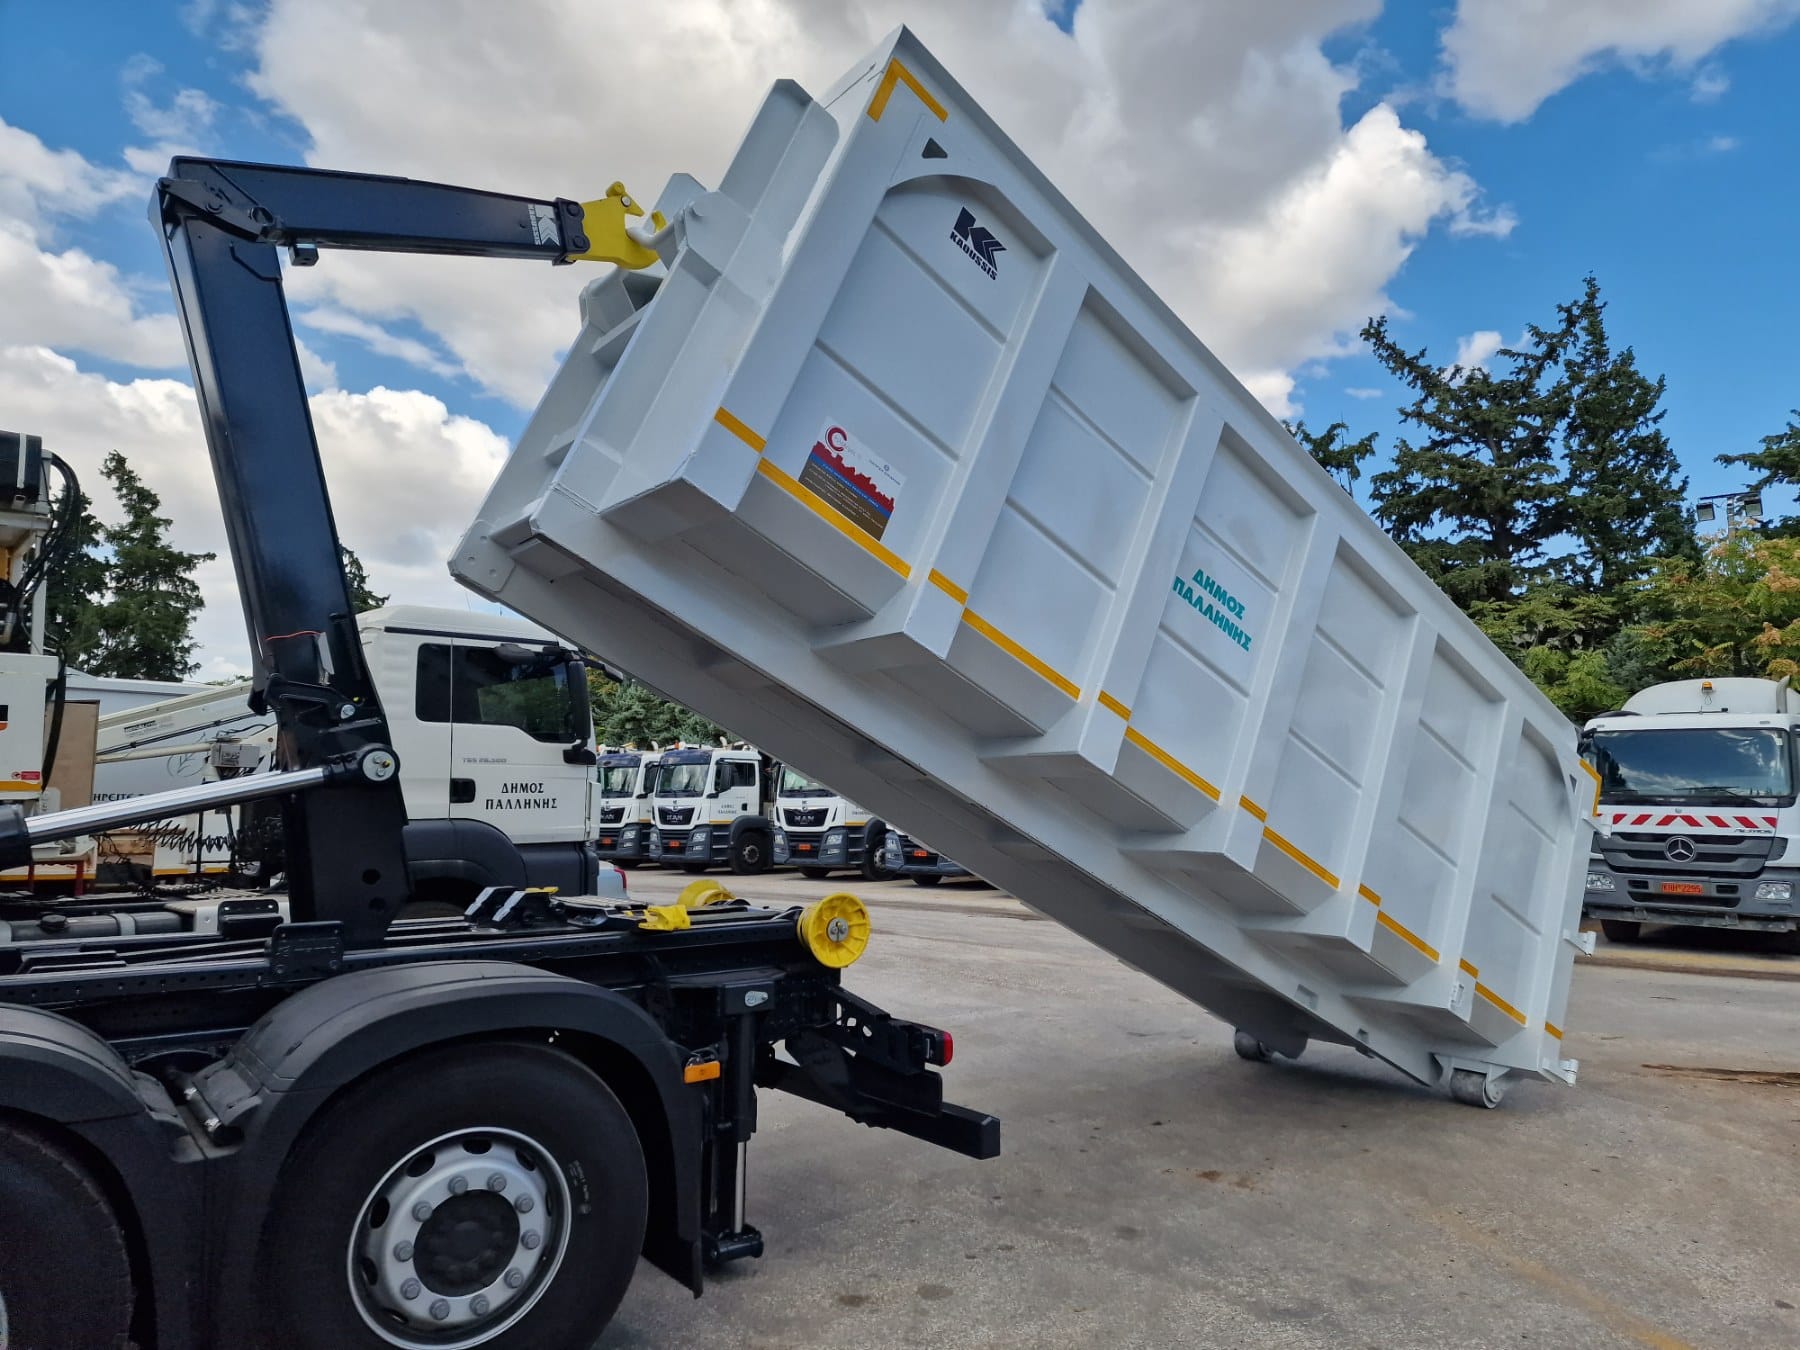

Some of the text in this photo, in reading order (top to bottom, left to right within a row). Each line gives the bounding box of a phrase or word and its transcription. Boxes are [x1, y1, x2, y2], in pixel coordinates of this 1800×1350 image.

[949, 230, 998, 281] KAOUSSIS
[1192, 568, 1246, 620] ΔΗΜΟΣ
[1172, 576, 1252, 652] ΠΑΛΛΗΝΗΣ
[501, 782, 544, 793] ΔΗΜΟΣ
[485, 798, 557, 810] ΠΑΛΛΗΝΗΣ
[794, 815, 815, 823] MAN
